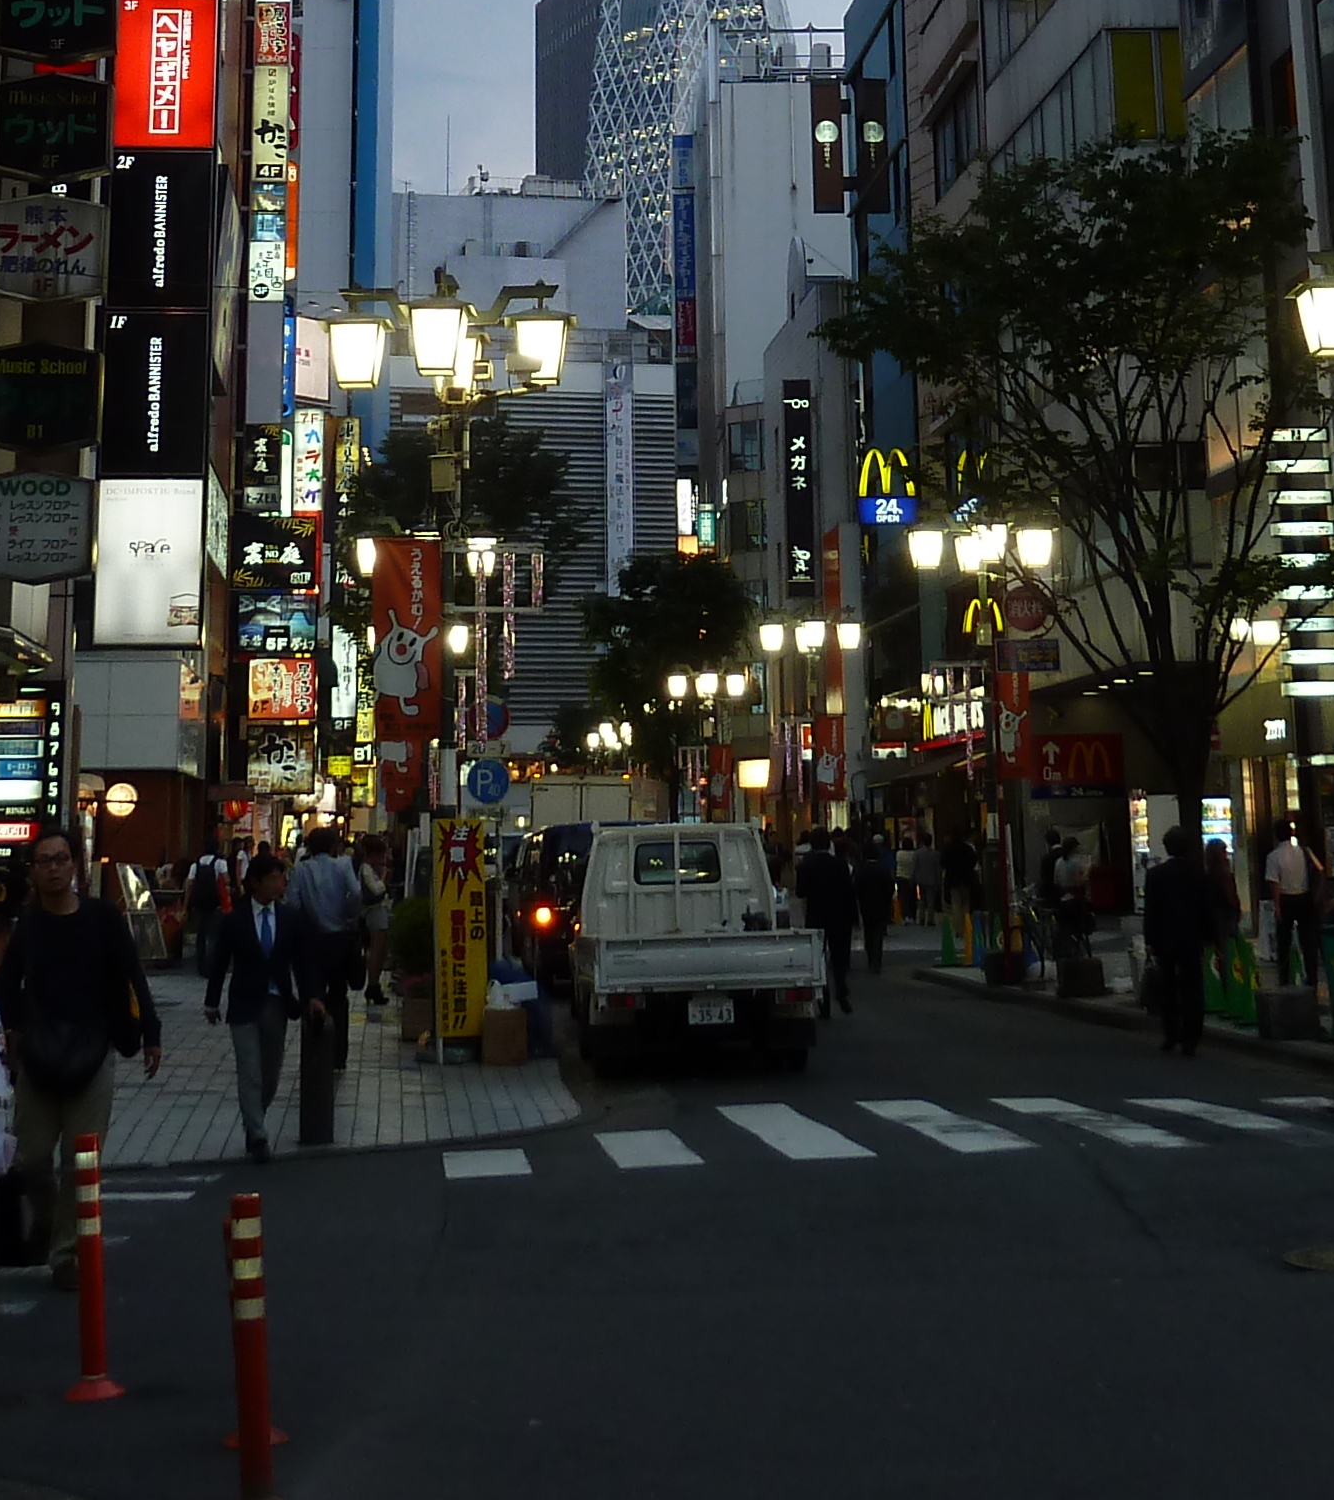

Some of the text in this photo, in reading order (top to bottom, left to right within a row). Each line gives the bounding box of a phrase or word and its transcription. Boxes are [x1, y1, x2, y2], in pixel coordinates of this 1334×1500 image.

[124, 0, 139, 11] 3F
[49, 38, 66, 50] 3F
[3, 112, 98, 145] ウッド
[115, 155, 136, 170] 2F
[258, 164, 281, 177] 4F
[153, 174, 169, 238] BANNISTER
[24, 205, 68, 225] 熊本
[0, 254, 87, 277] 肥後のれん
[110, 315, 128, 330] 1F
[40, 359, 88, 375] School
[147, 336, 163, 399] BANNISTER
[300, 412, 320, 425] 7F
[789, 435, 807, 492] メガネ
[0, 479, 71, 497] WOOD
[875, 514, 901, 523] OPEN
[51, 702, 60, 716] 9
[50, 721, 60, 736] 8
[49, 741, 60, 756] 7
[354, 746, 374, 763] B1
[48, 762, 59, 777] 6
[48, 781, 59, 798] 5
[475, 769, 489, 798] P
[697, 1007, 733, 1023] 35-43
